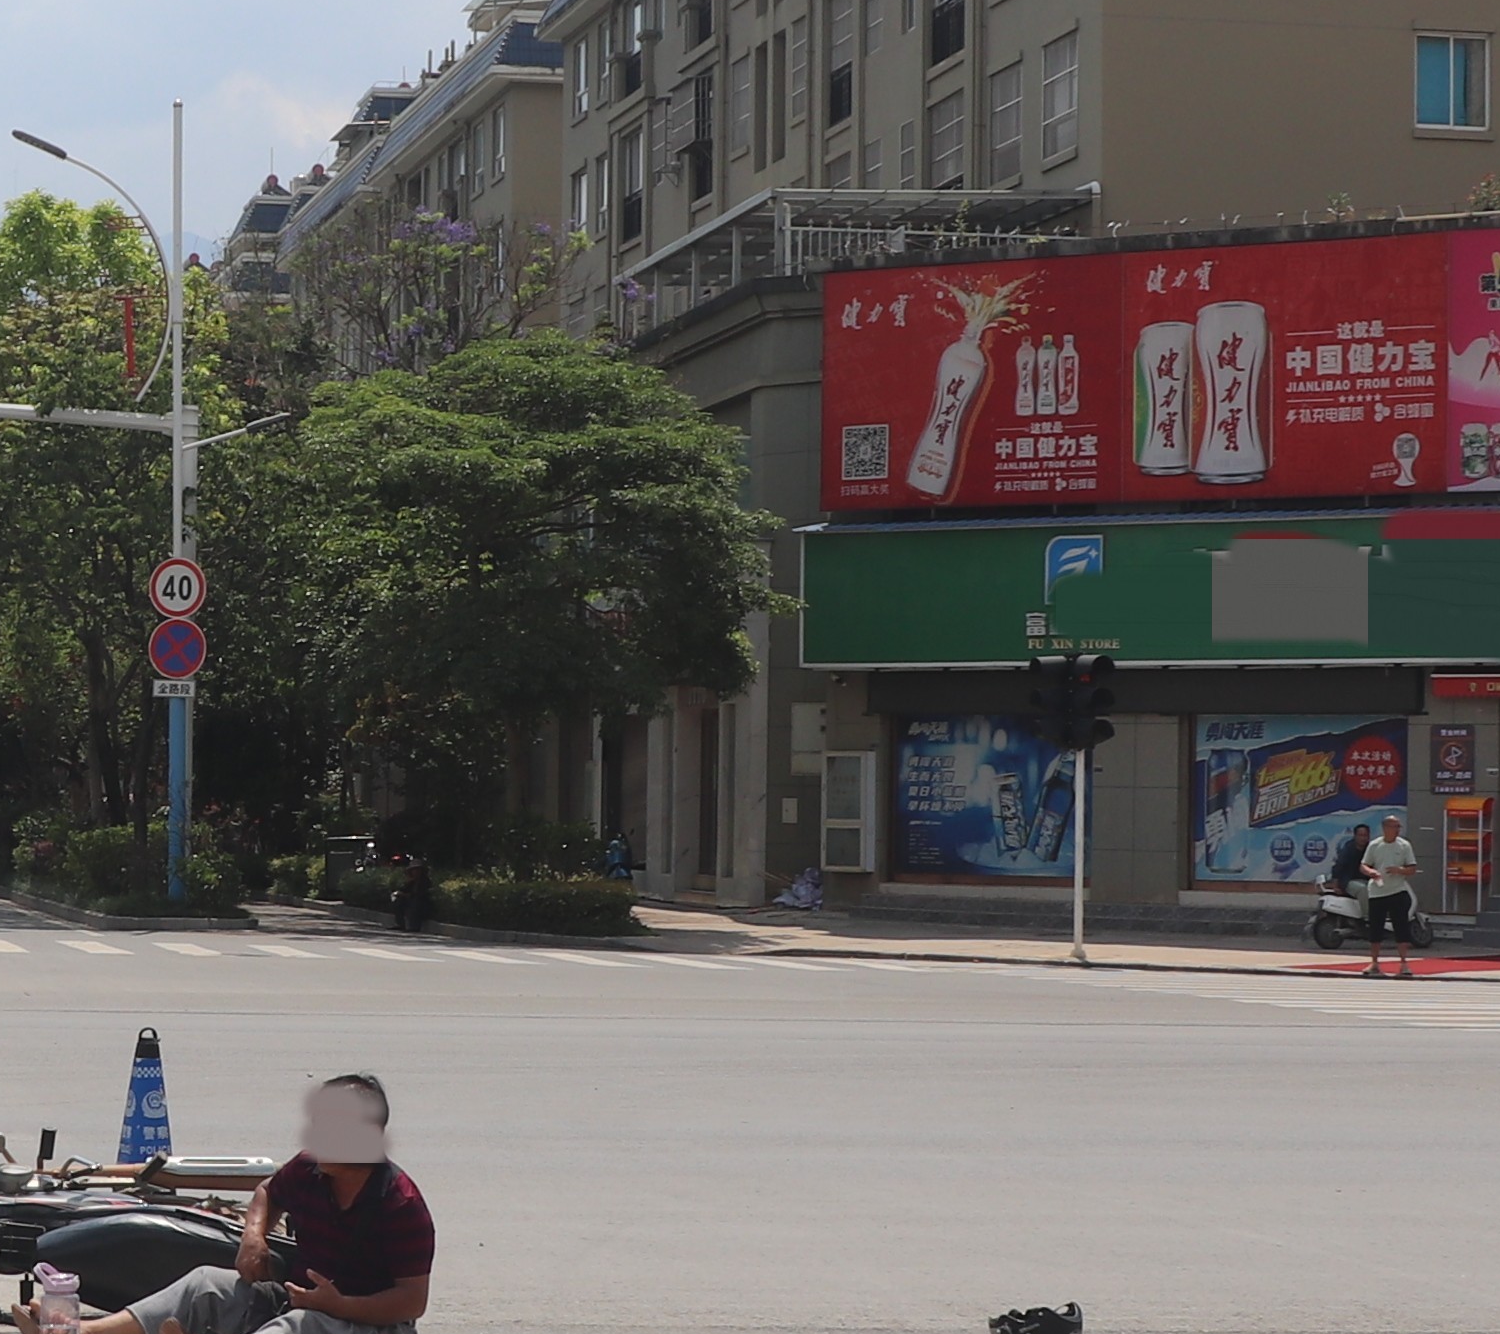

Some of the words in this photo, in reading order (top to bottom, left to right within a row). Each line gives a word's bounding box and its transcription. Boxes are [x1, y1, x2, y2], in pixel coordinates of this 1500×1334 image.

[1337, 320, 1385, 339] 这就是
[1286, 339, 1436, 376] 中国健力宝
[1286, 379, 1350, 393] JIANLIBAO
[1356, 377, 1390, 390] FROM
[1395, 375, 1435, 387] CHINA
[1299, 406, 1364, 424] 补充电解质
[995, 434, 1098, 459] 中国健力宝
[1043, 460, 1067, 469] FROM
[1070, 458, 1097, 468] CHINA
[162, 575, 192, 601] 40
[1026, 612, 1056, 636] 富
[1028, 639, 1044, 649] FU
[1051, 639, 1073, 649] XIN
[1080, 638, 1120, 649] STORE
[158, 683, 191, 695] 全路段
[1206, 721, 1265, 742] 勇闯天涯
[1351, 751, 1392, 761] 本次活动
[1345, 765, 1396, 776] 综合中奖率
[1360, 779, 1382, 790] 50%
